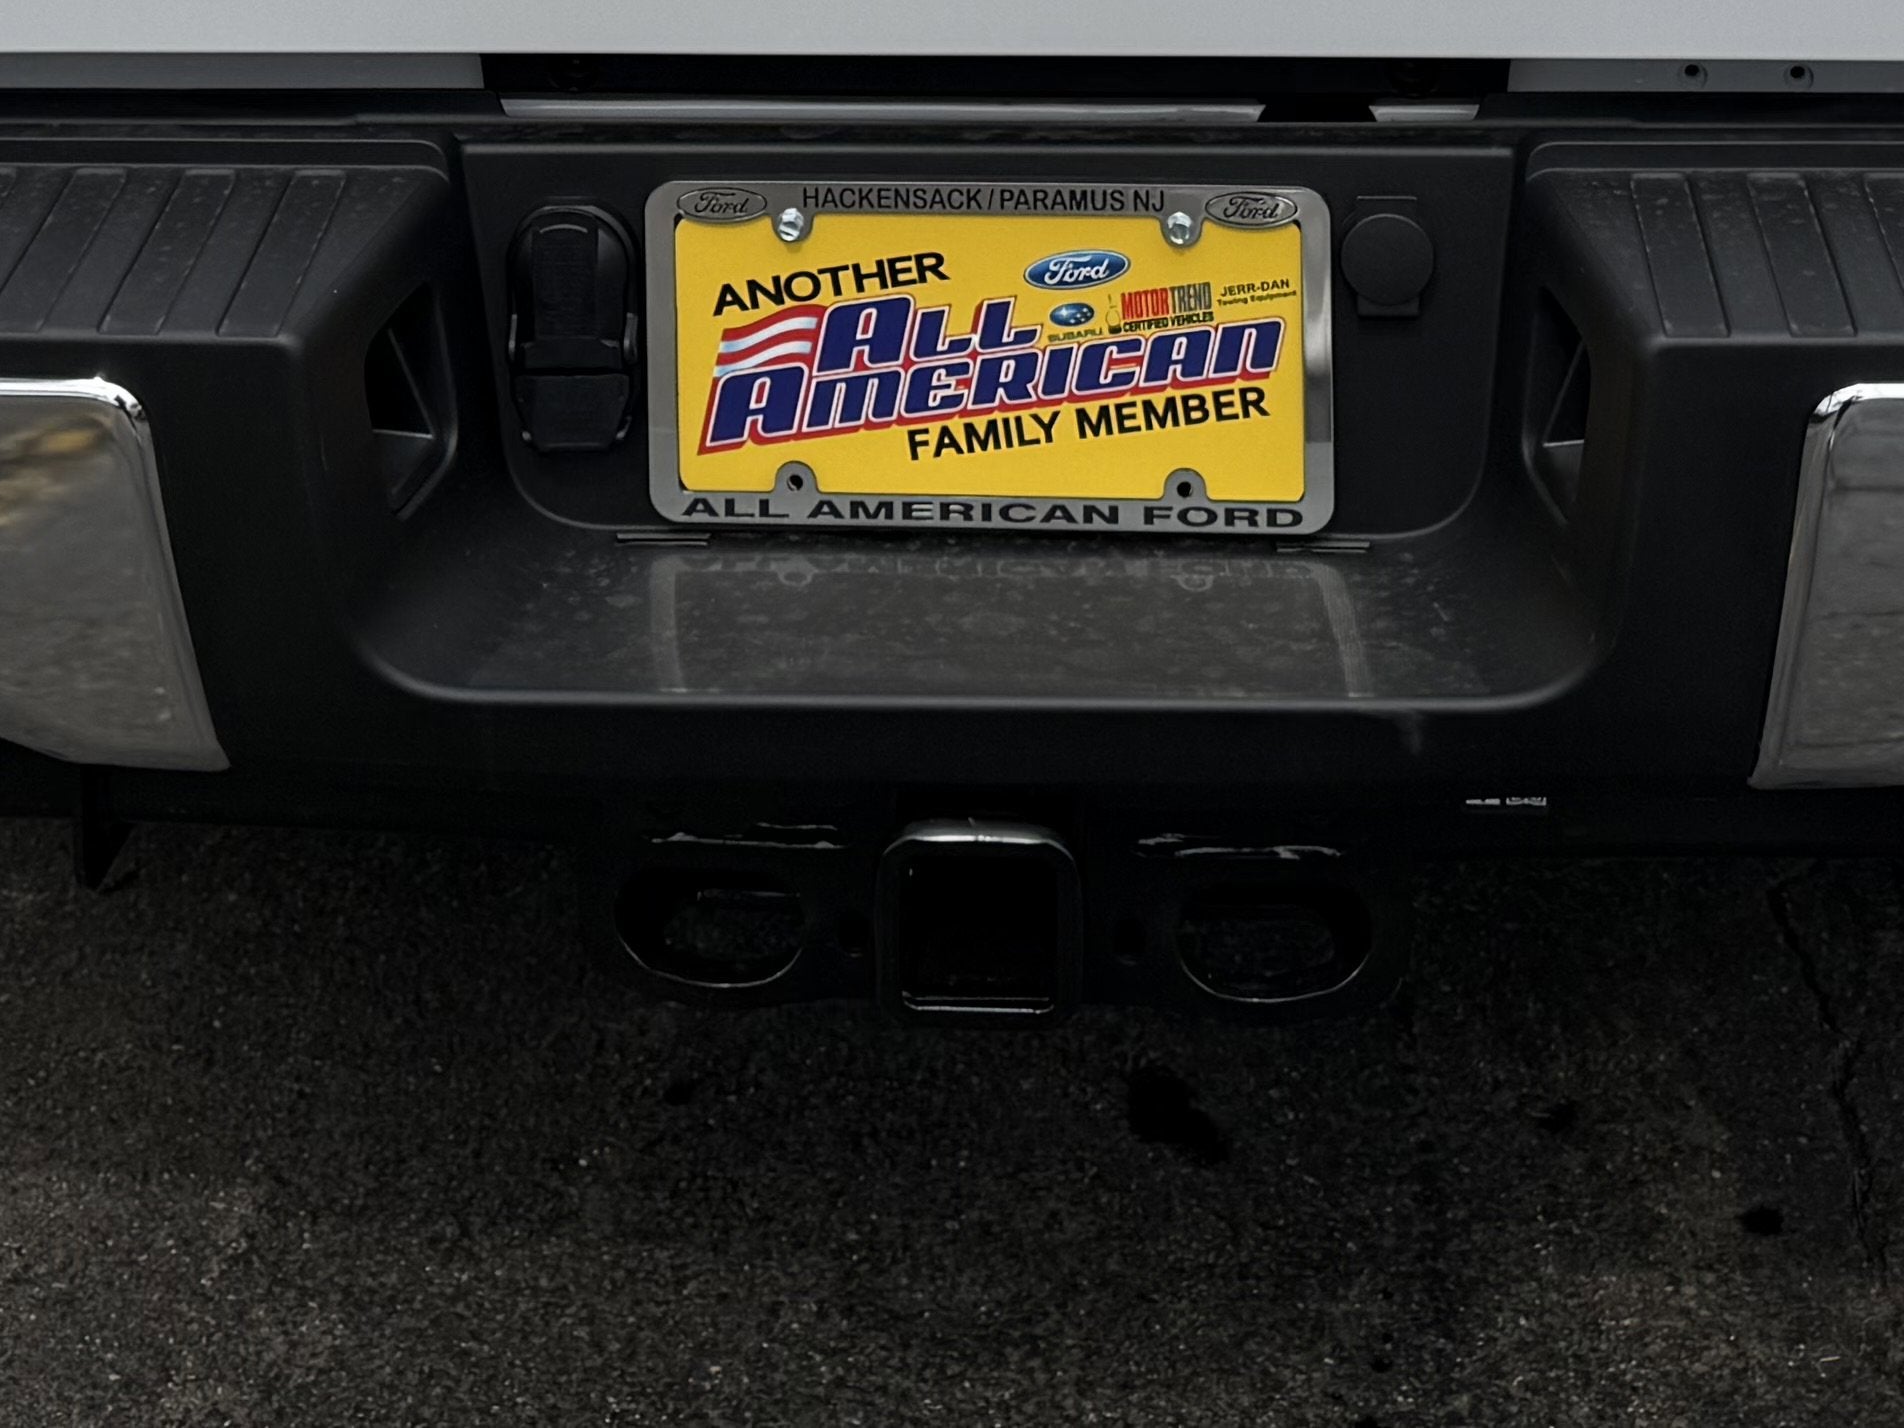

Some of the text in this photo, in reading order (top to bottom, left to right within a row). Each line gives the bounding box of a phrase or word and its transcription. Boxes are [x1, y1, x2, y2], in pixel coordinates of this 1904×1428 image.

[694, 192, 750, 215] Ford
[1133, 190, 1165, 212] NJ
[1222, 195, 1280, 220] Ford
[1044, 255, 1110, 284] Ford
[712, 251, 952, 317] ANOTHER
[1220, 278, 1290, 297] JERR-DAN
[812, 293, 1043, 376] ALL
[1048, 327, 1103, 343] SUBARU
[1122, 311, 1214, 333] CERTIFIED VEHICLES
[701, 317, 1286, 452] AMERICAN
[907, 386, 1270, 461] FAMILY MEMBER
[682, 497, 1304, 529] ALL AMERICAN FORD
